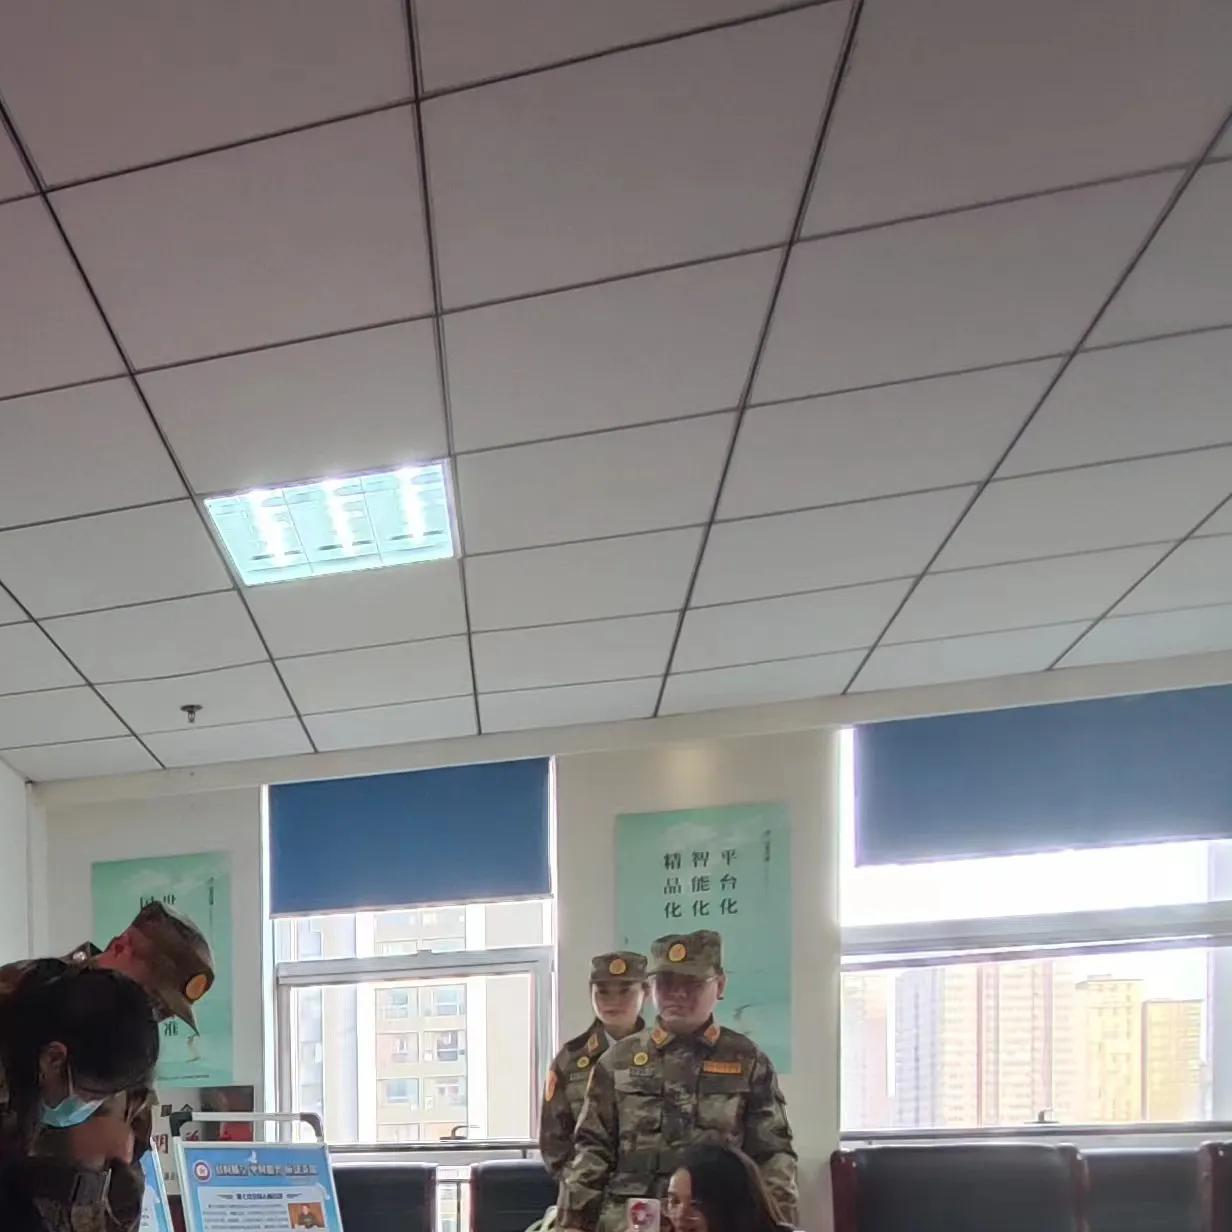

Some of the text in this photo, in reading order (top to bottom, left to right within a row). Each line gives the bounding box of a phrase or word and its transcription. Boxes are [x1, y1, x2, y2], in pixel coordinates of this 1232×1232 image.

[664, 852, 682, 918] 精品化
[692, 851, 710, 917] 智能化
[720, 849, 738, 915] 平台化
